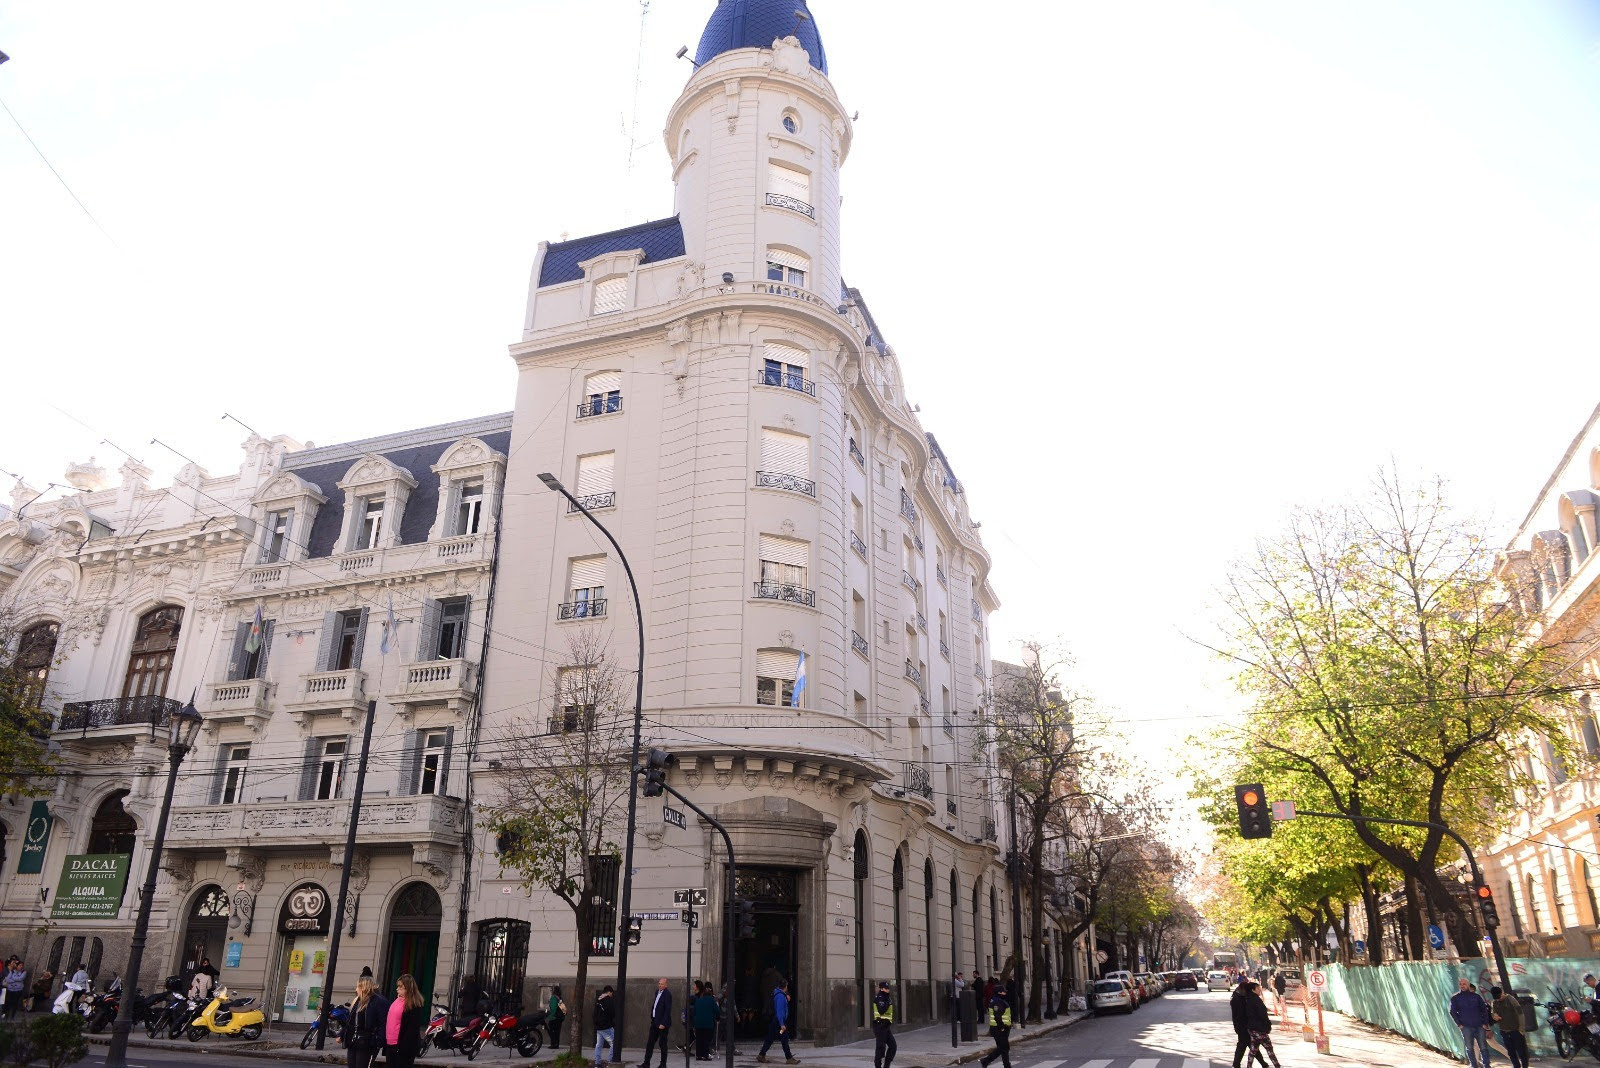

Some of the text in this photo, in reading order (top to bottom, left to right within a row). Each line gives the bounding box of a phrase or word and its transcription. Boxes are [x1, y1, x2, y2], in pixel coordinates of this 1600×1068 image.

[667, 714, 716, 726] BANCO
[722, 714, 814, 731] MUNICIPAL
[665, 808, 680, 825] CALLE
[71, 860, 118, 870] DACAL
[72, 887, 105, 896] ALQUILA
[678, 893, 684, 902] 7
